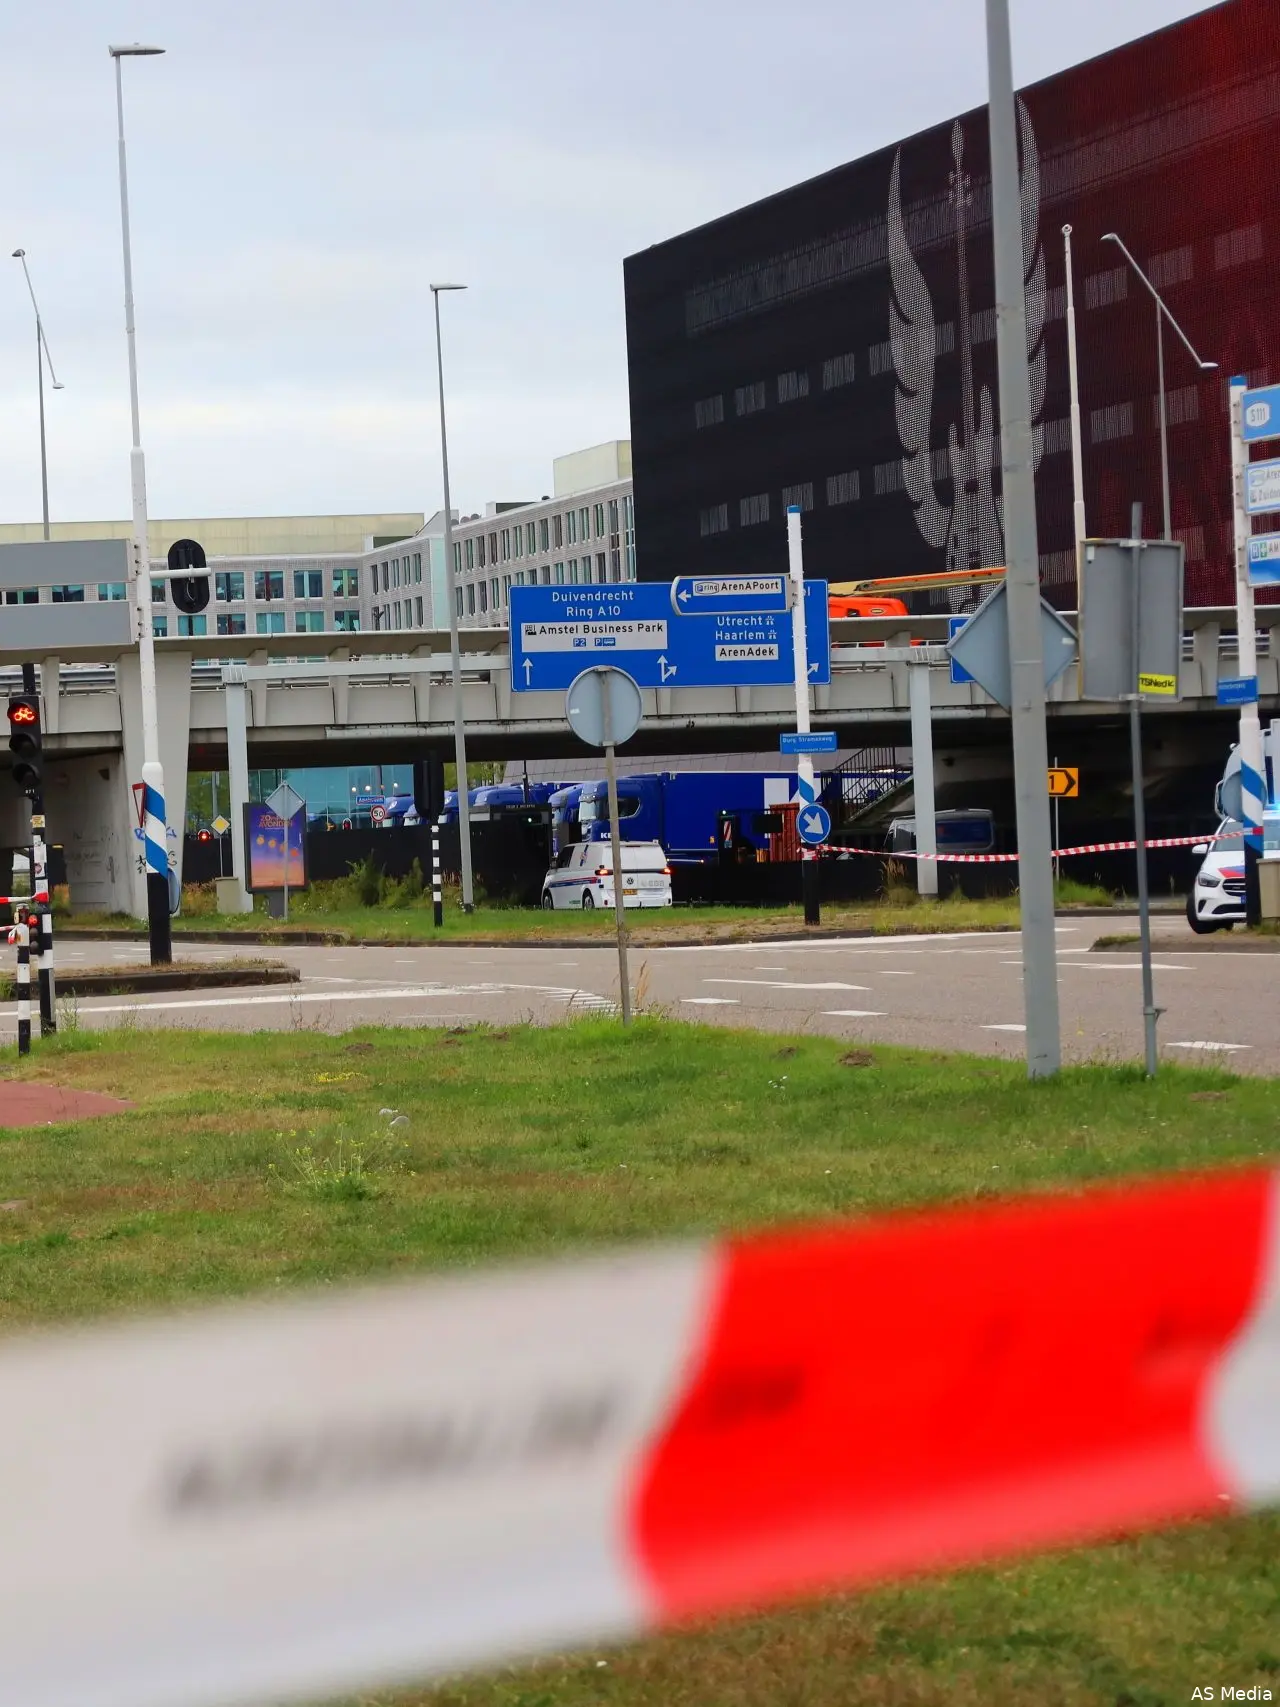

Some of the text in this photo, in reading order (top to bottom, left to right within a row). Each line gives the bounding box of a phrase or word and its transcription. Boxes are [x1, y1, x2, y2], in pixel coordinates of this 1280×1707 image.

[552, 590, 634, 602] Duivendrecht
[566, 605, 621, 619] Ring A10
[717, 615, 763, 627] Utrecht
[539, 622, 664, 635] Amstel Business Park
[715, 630, 765, 641] Haarlem
[720, 647, 775, 657] ArenAdek
[373, 809, 383, 818] 50
